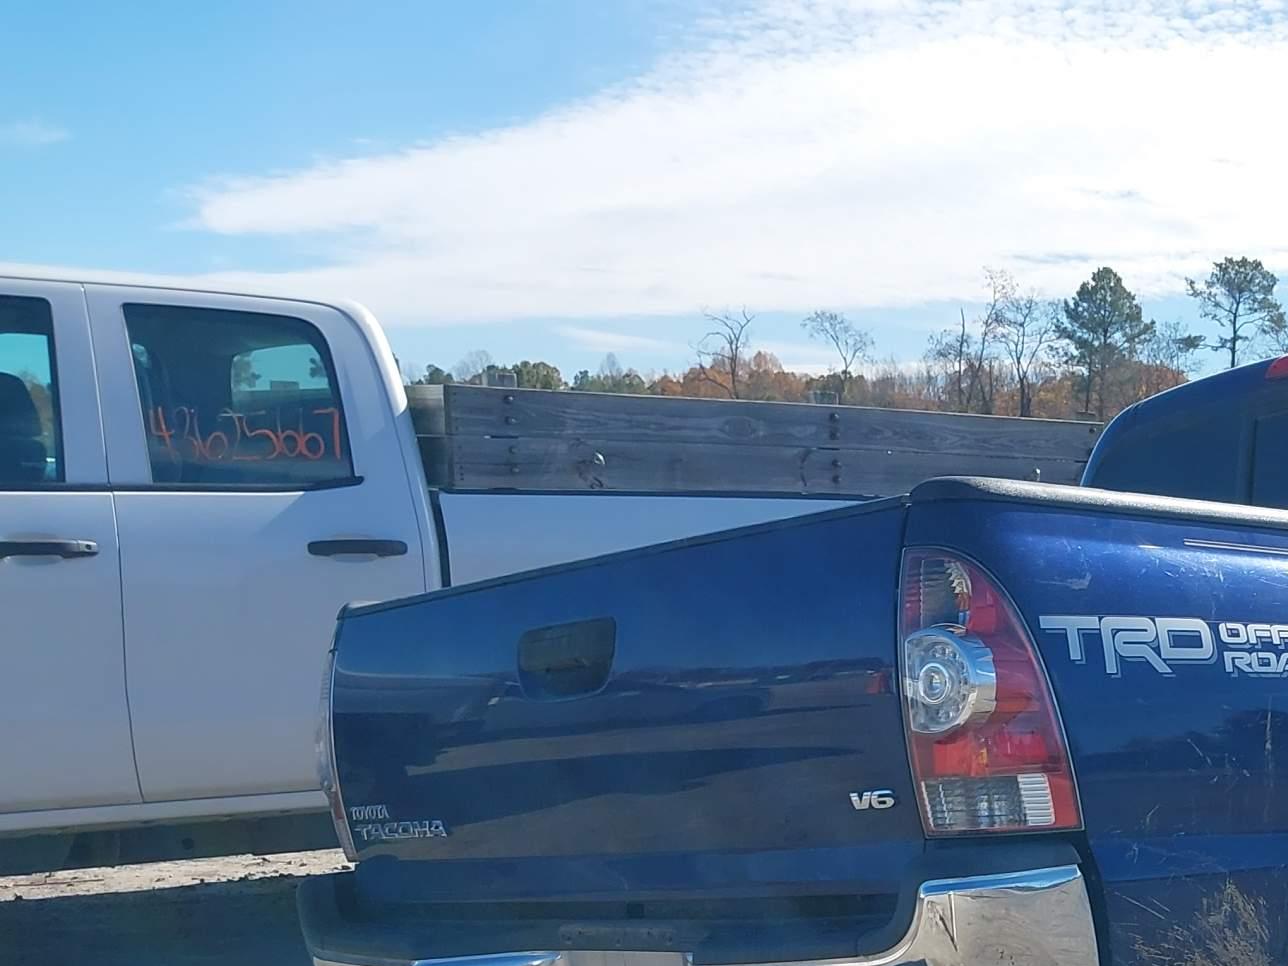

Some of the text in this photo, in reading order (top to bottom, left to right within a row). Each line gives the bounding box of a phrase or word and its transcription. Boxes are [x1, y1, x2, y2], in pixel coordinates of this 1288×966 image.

[1039, 615, 1217, 677] TRD
[849, 789, 895, 810] V6
[354, 820, 448, 841] TACOMA
